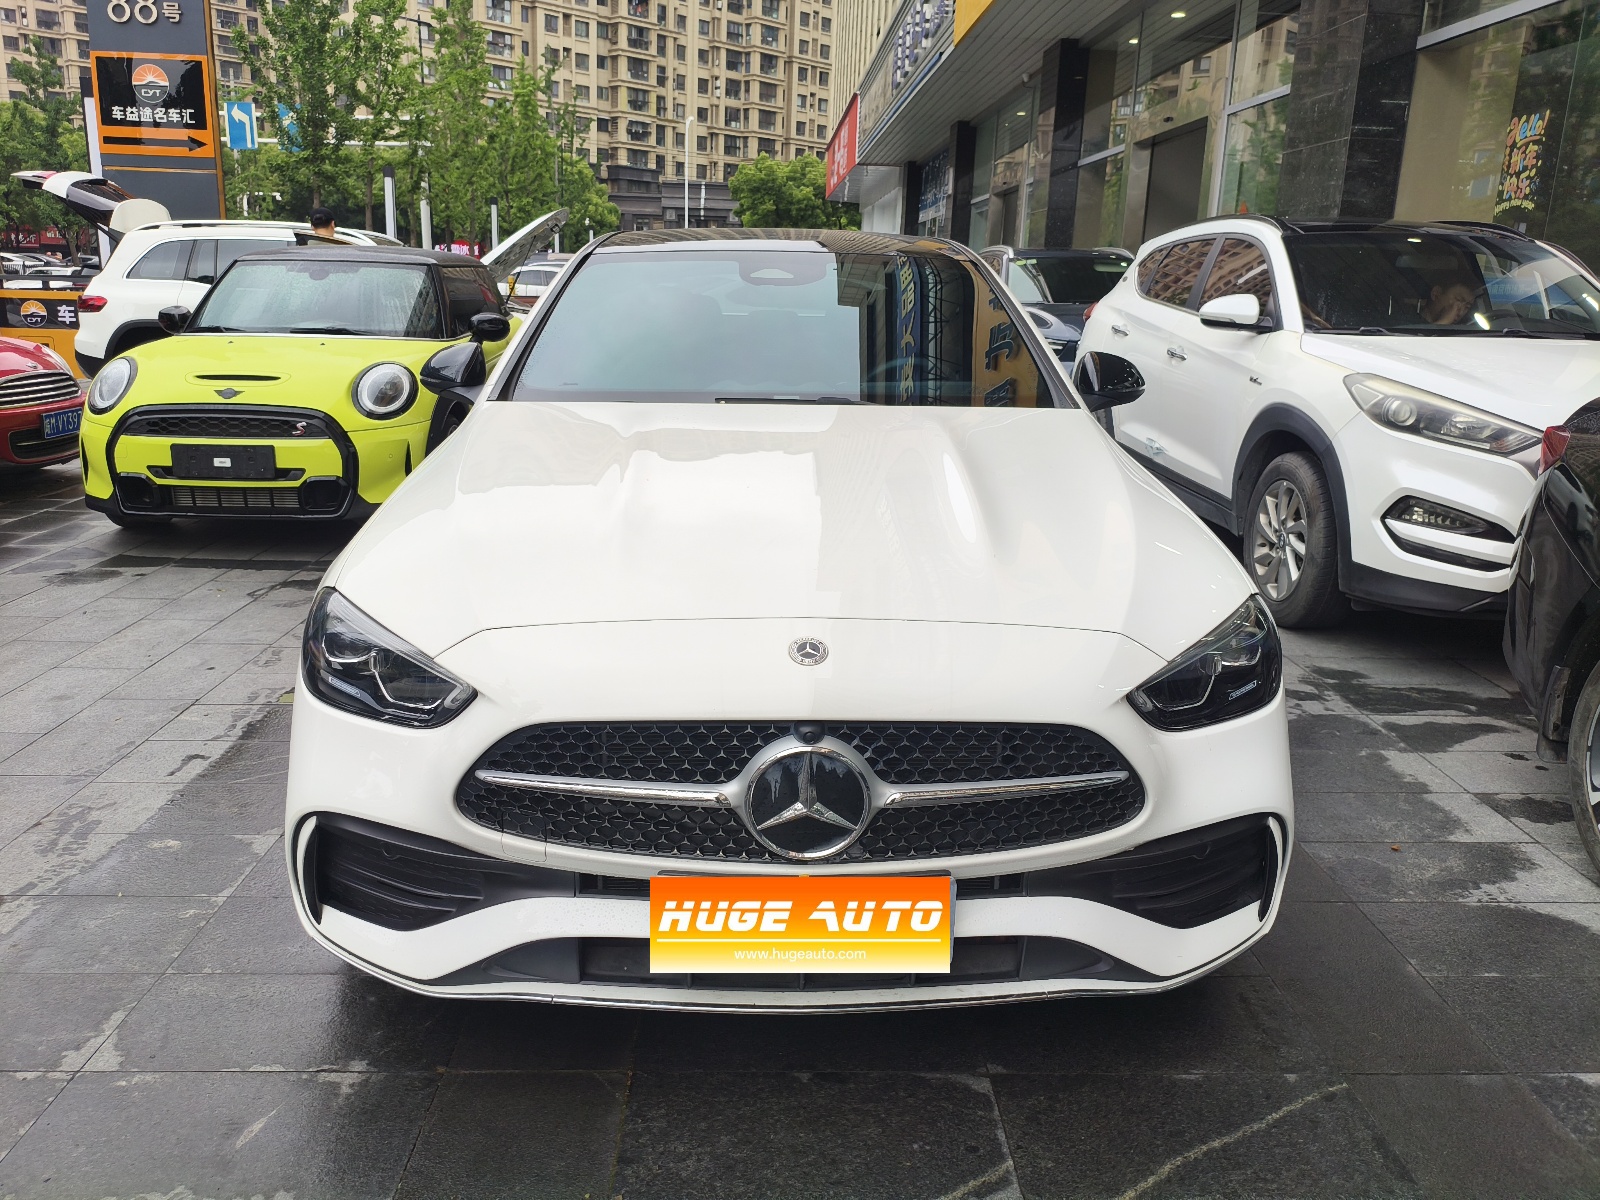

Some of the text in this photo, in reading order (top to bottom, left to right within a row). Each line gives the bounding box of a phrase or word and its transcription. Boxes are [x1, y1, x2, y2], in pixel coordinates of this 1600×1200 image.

[141, 88, 161, 97] CYT
[112, 105, 196, 124] 车益途名车汇
[1507, 109, 1550, 147] Hello!
[1509, 142, 1538, 174] 新年
[1503, 170, 1530, 199] 快乐
[57, 305, 76, 324] 车
